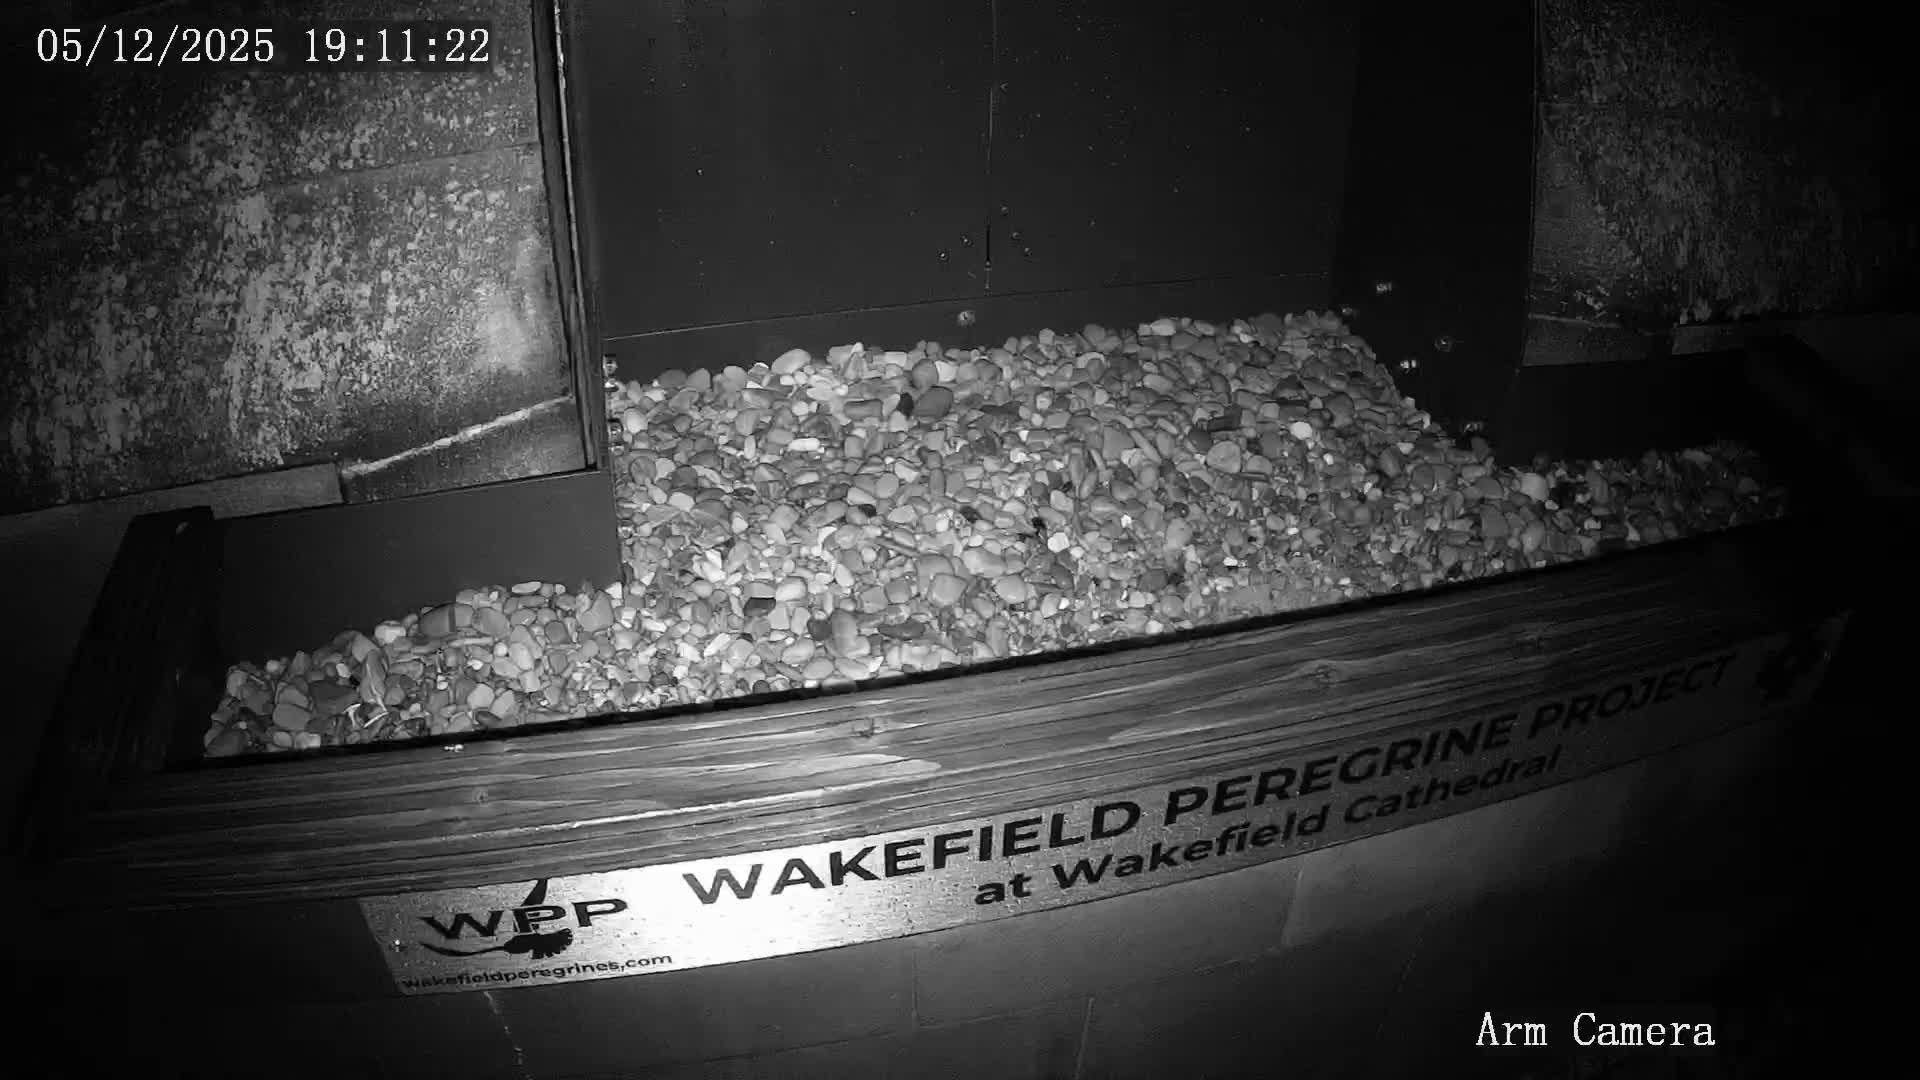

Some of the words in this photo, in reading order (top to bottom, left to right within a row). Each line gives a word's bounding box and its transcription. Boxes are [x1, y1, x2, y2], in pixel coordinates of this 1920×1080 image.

[682, 801, 1141, 905] WAKEFIELD
[1163, 713, 1518, 827] PEREGRINE
[1527, 651, 1737, 739] PROJECT
[975, 871, 1032, 906] at
[1052, 804, 1330, 890] Wakefield
[1343, 744, 1563, 824] Cathedral
[418, 898, 628, 940] WPP
